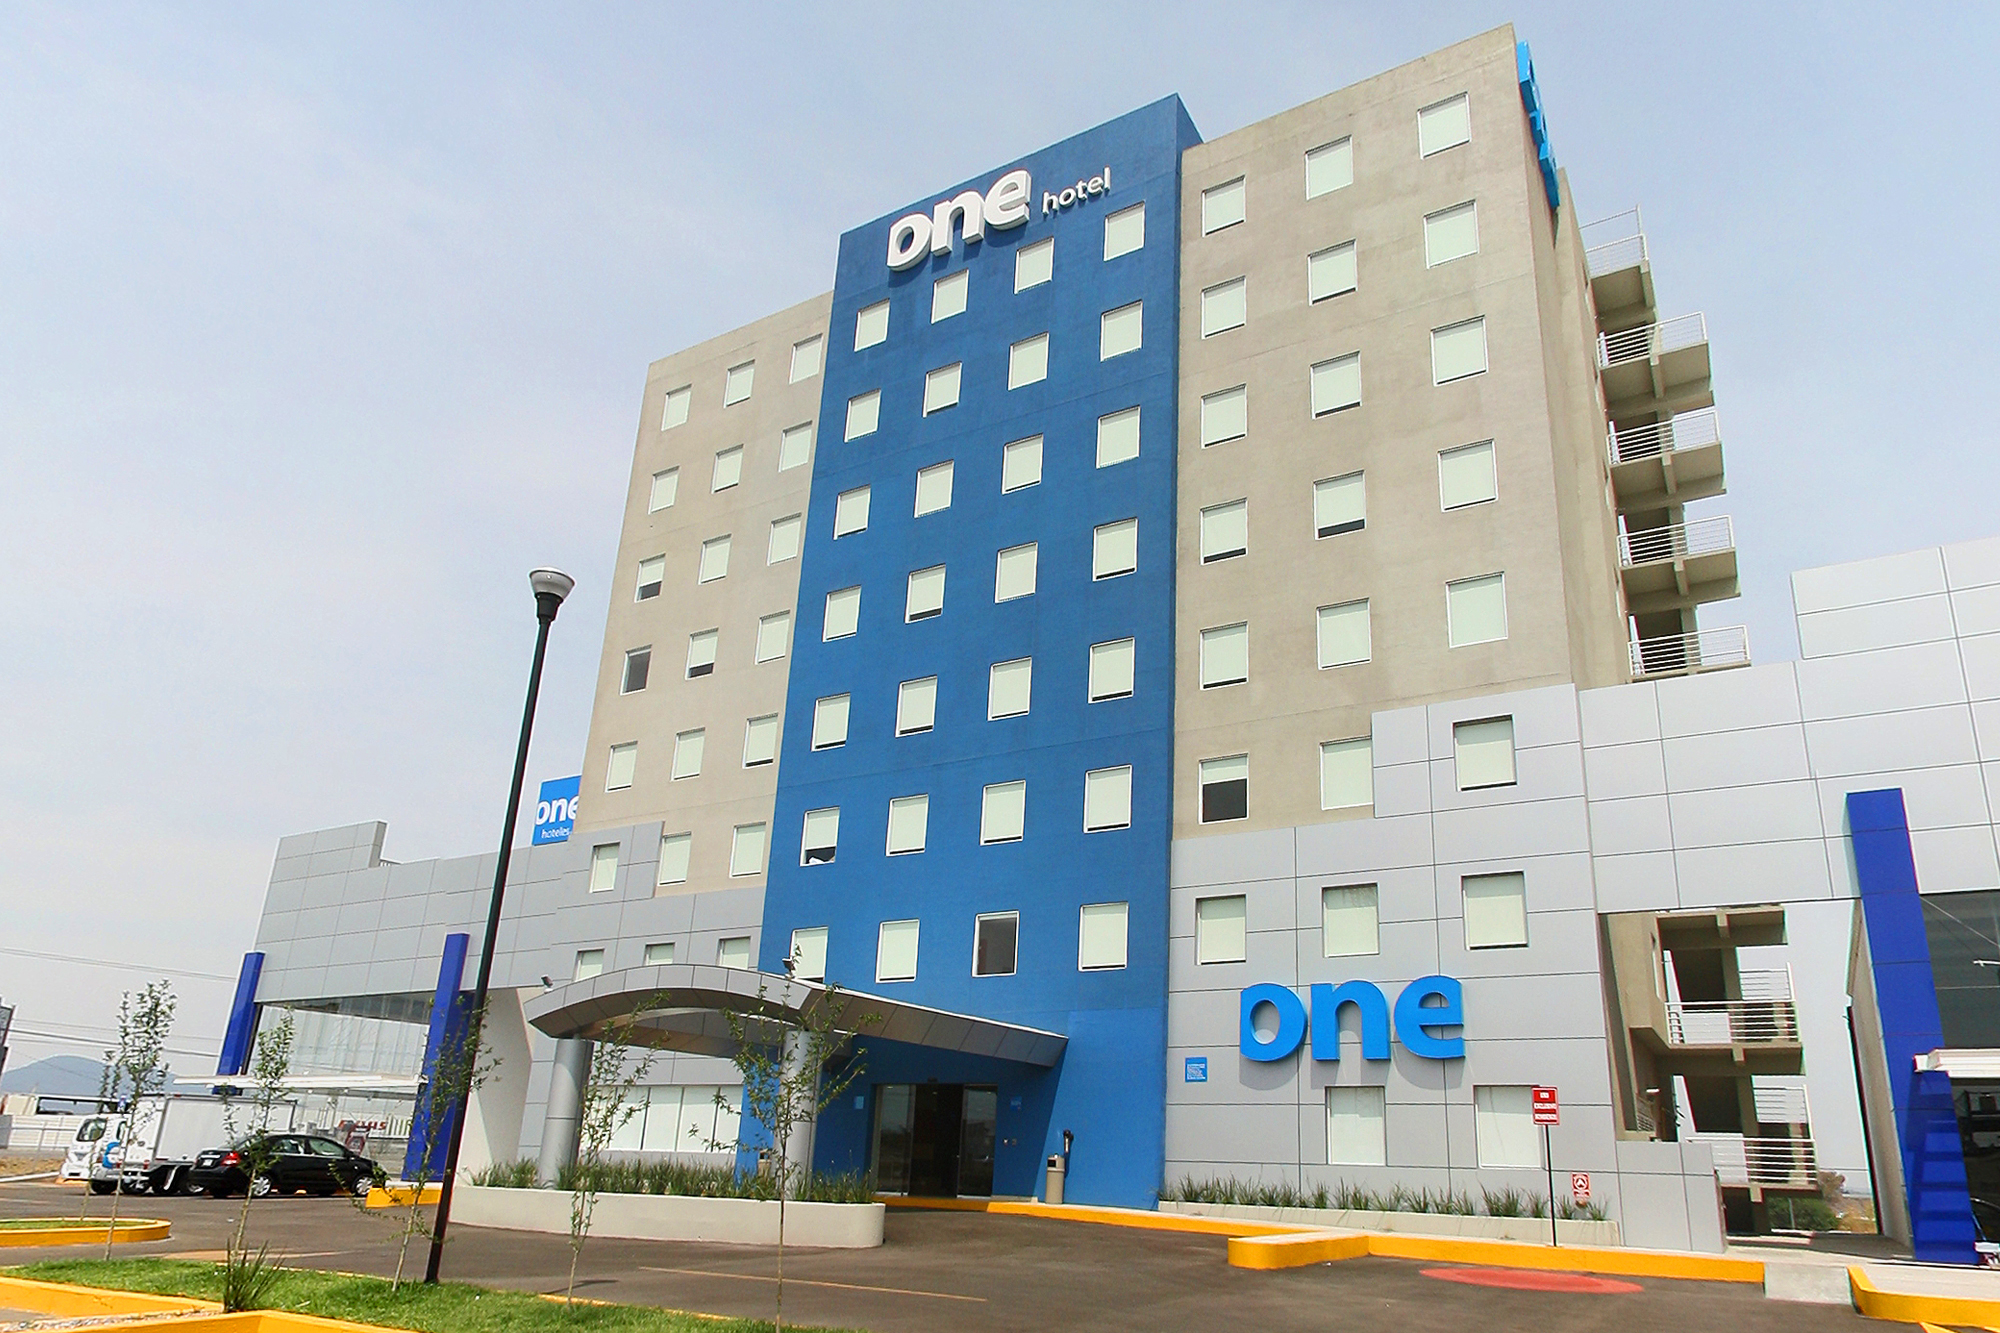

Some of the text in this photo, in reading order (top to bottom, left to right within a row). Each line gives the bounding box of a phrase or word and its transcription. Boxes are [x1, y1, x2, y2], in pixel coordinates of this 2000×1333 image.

[887, 166, 1111, 271] one hotel
[1240, 975, 1465, 1061] one
